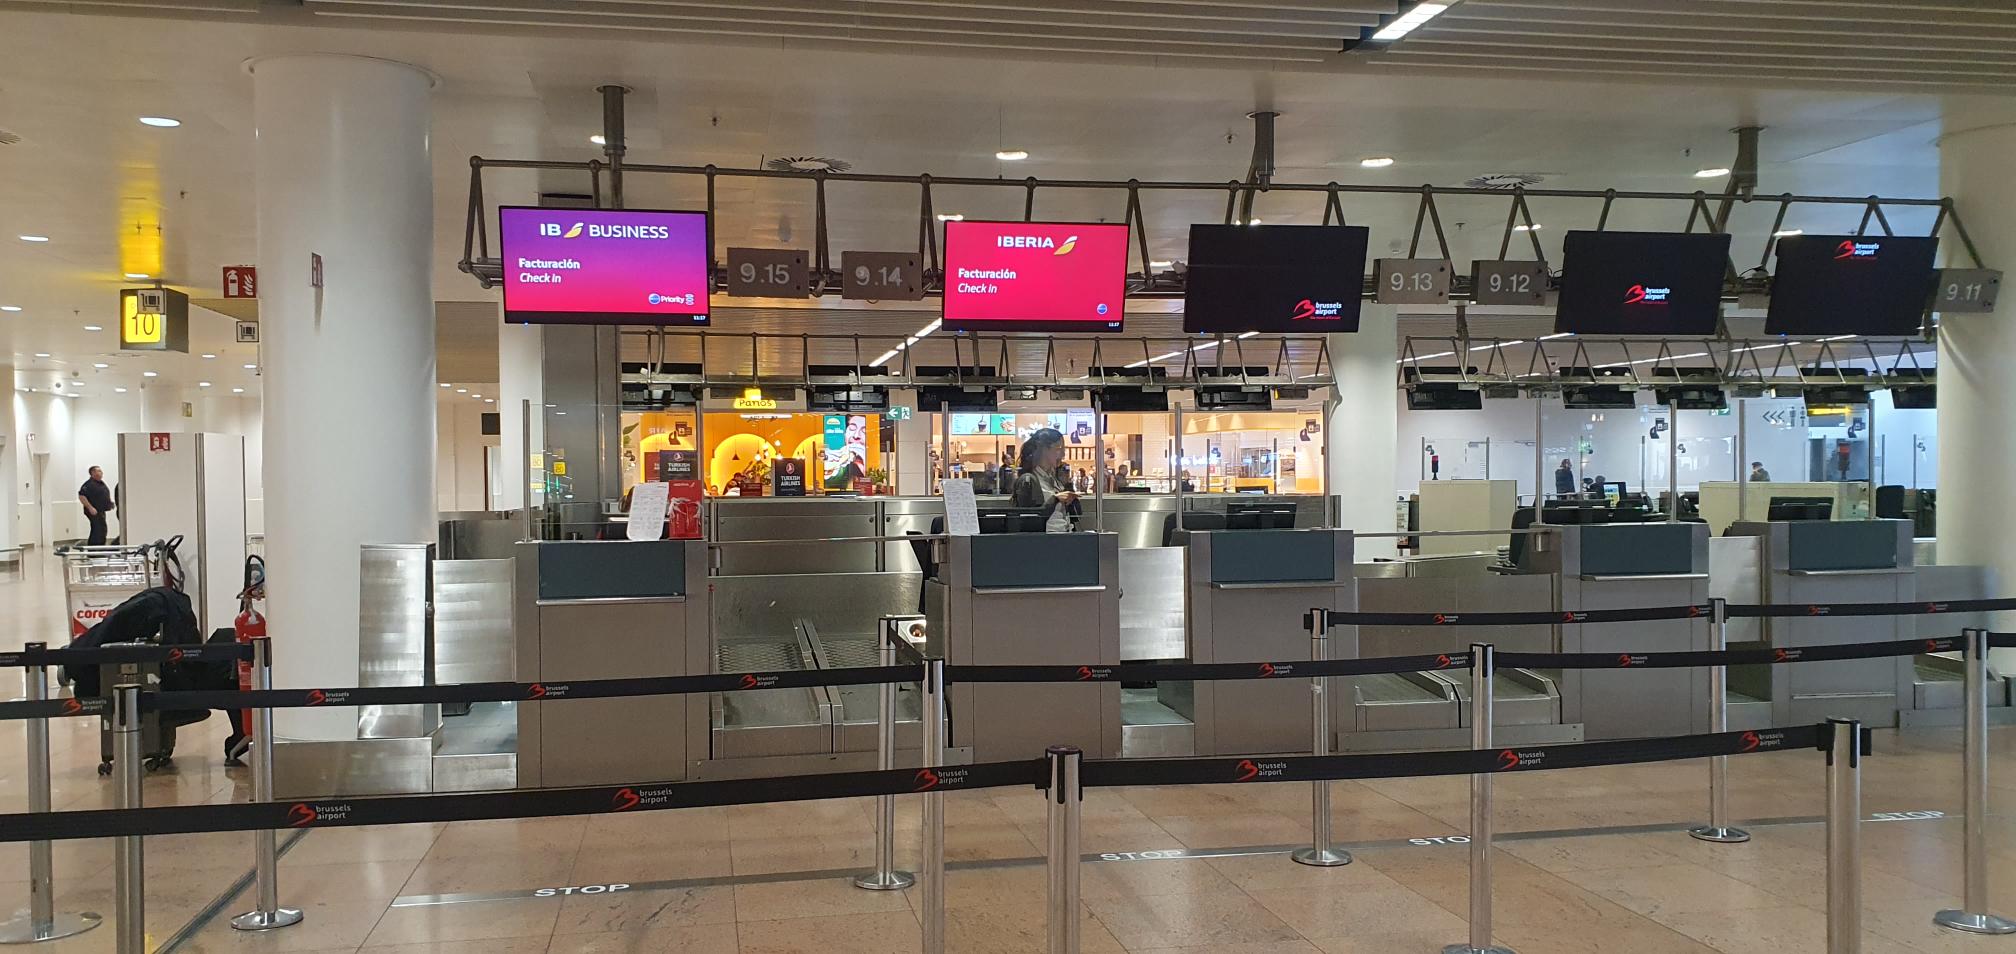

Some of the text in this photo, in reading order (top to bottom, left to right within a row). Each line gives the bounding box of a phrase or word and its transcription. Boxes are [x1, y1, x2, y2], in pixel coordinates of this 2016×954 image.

[540, 223, 669, 239] IB BUSINESS
[997, 235, 1055, 249] IBERIA
[518, 258, 581, 270] Facturación
[519, 273, 562, 284] Check in
[740, 263, 790, 285] 9.15
[855, 265, 903, 287] 9.14
[958, 268, 1017, 280] Facturación
[1390, 272, 1433, 292] 9.13
[1489, 273, 1531, 293] 9.12
[957, 283, 998, 294] Check in
[1946, 283, 1982, 301] 9.11
[1315, 308, 1337, 316] airport
[131, 312, 155, 336] 10
[739, 399, 773, 407] Panos
[1518, 750, 1545, 758] brussels
[1519, 758, 1541, 766] airport
[938, 769, 969, 777] brussels
[939, 777, 964, 785] airport
[639, 788, 673, 796] brussels
[640, 796, 668, 804] airport
[315, 804, 352, 812] brussels
[316, 811, 346, 820] airport
[1408, 835, 1472, 846] STO
[1100, 849, 1185, 861] STOP
[534, 883, 630, 897] STOP
